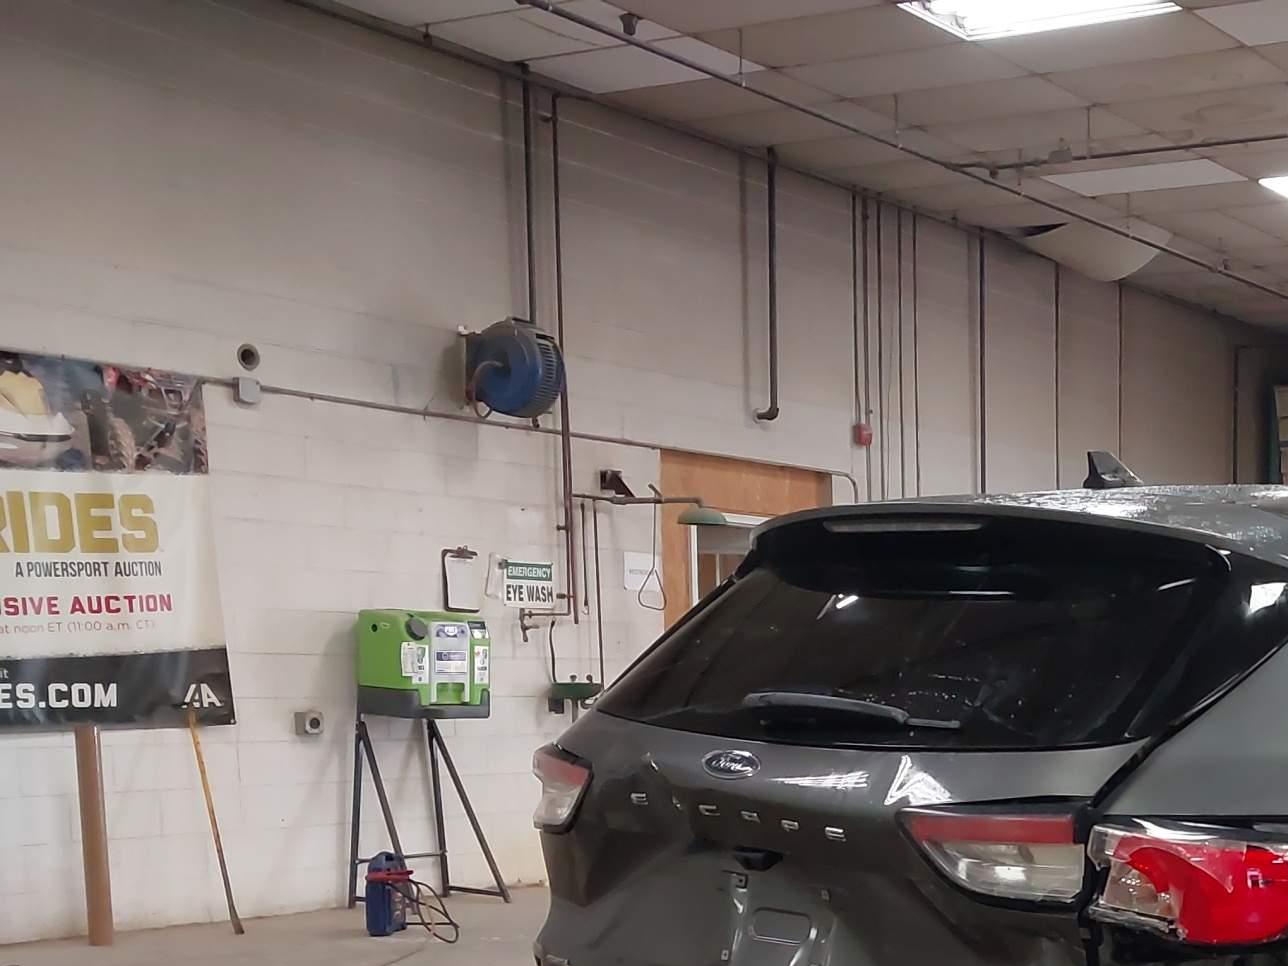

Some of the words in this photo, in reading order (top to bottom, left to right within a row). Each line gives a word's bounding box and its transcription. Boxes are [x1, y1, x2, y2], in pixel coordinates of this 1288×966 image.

[15, 562, 24, 578] A
[27, 561, 110, 578] POWERSPORT
[114, 560, 163, 577] AUCTION
[507, 565, 551, 578] EMERGENCY
[506, 584, 524, 601] EYE
[527, 585, 554, 603] WASH
[0, 596, 60, 616] SIVE
[70, 593, 173, 615] AUCTION
[48, 621, 63, 633] ET
[0, 682, 118, 709] ES.COM
